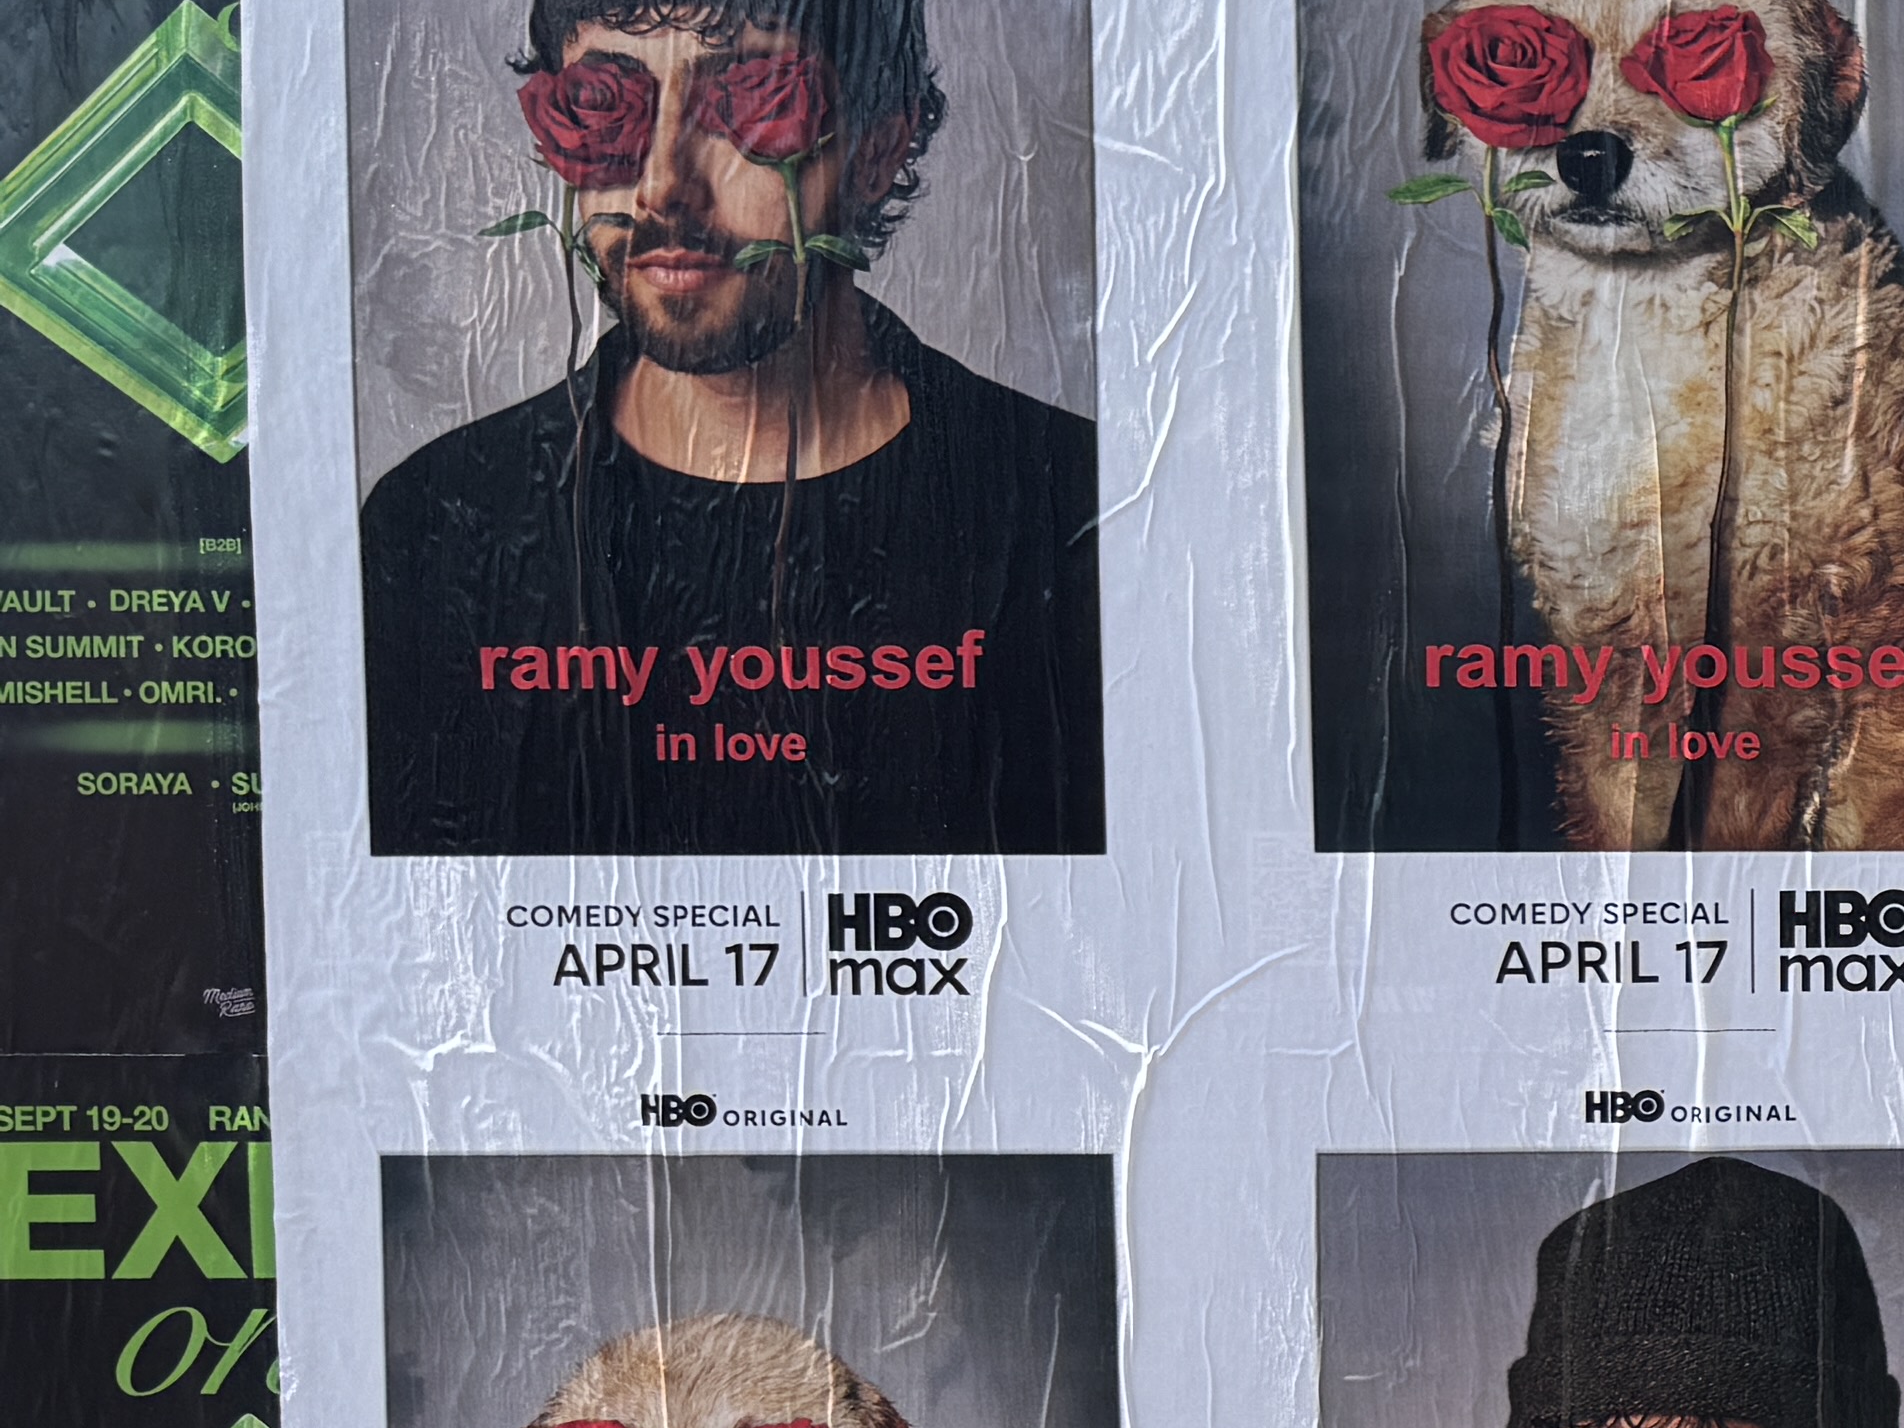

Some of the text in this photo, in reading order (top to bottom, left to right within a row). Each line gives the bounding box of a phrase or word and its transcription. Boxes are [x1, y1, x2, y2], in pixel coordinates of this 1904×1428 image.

[199, 537, 242, 555] [B2B]
[0, 590, 231, 613] AULT DREYA V
[25, 635, 145, 659] SUMMIT
[479, 629, 985, 706] ramy youssef
[1424, 643, 1611, 704] ramy
[139, 680, 222, 705] OMRI.
[655, 724, 807, 762] in love
[1610, 722, 1761, 761] in love
[77, 772, 193, 796] SORAYA
[506, 904, 780, 928] COMEDY SPECIAL
[828, 891, 973, 952] HBO
[1450, 902, 1729, 925] COMEDY SPECIAL
[553, 943, 780, 986] APRIL 17
[829, 957, 969, 997] max
[1495, 941, 1728, 984] APRIL 17
[0, 1105, 77, 1132] SEPT
[86, 1105, 169, 1132] 19-20
[640, 1093, 847, 1127] HBO ORIGINAL
[1585, 1090, 1797, 1124] HBO ORIGINAL
